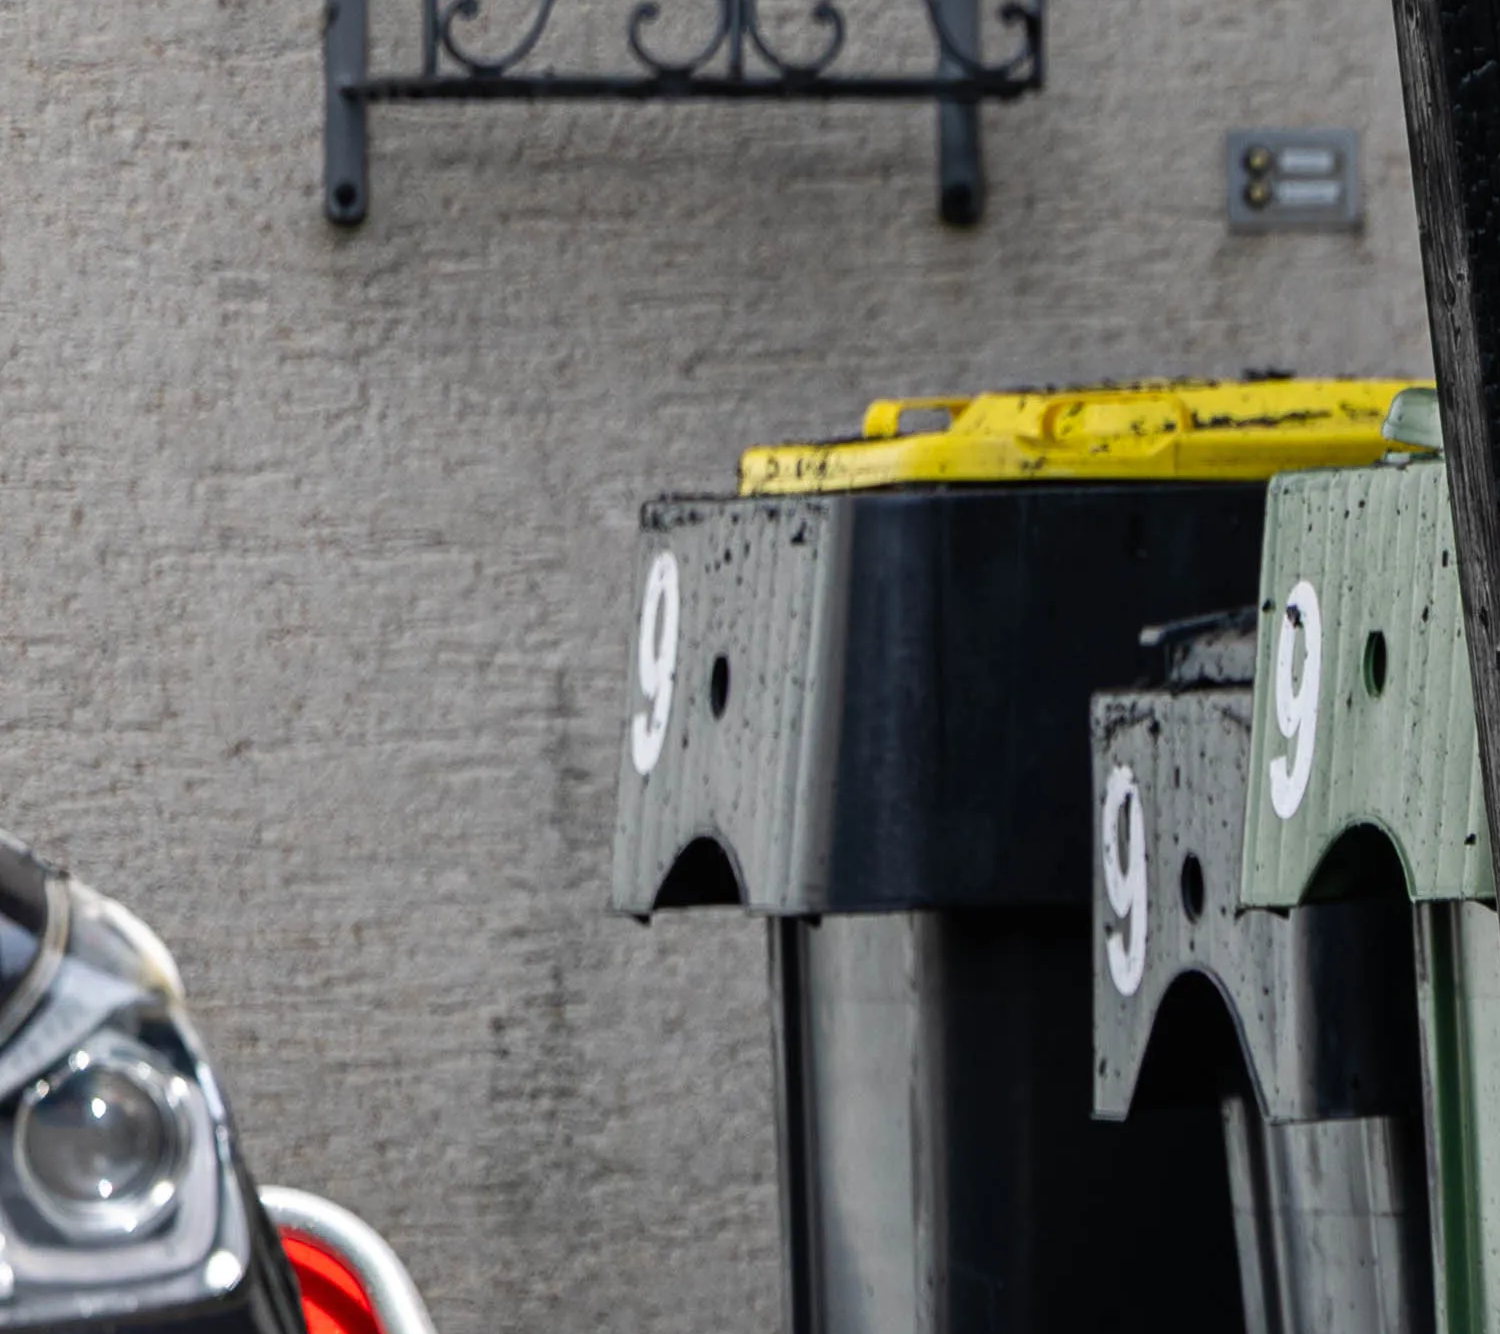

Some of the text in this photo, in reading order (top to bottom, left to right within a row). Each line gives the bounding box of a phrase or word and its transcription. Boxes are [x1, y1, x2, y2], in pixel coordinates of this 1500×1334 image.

[630, 550, 680, 777] 9
[1268, 579, 1324, 820] 9
[1101, 764, 1148, 997] 9
